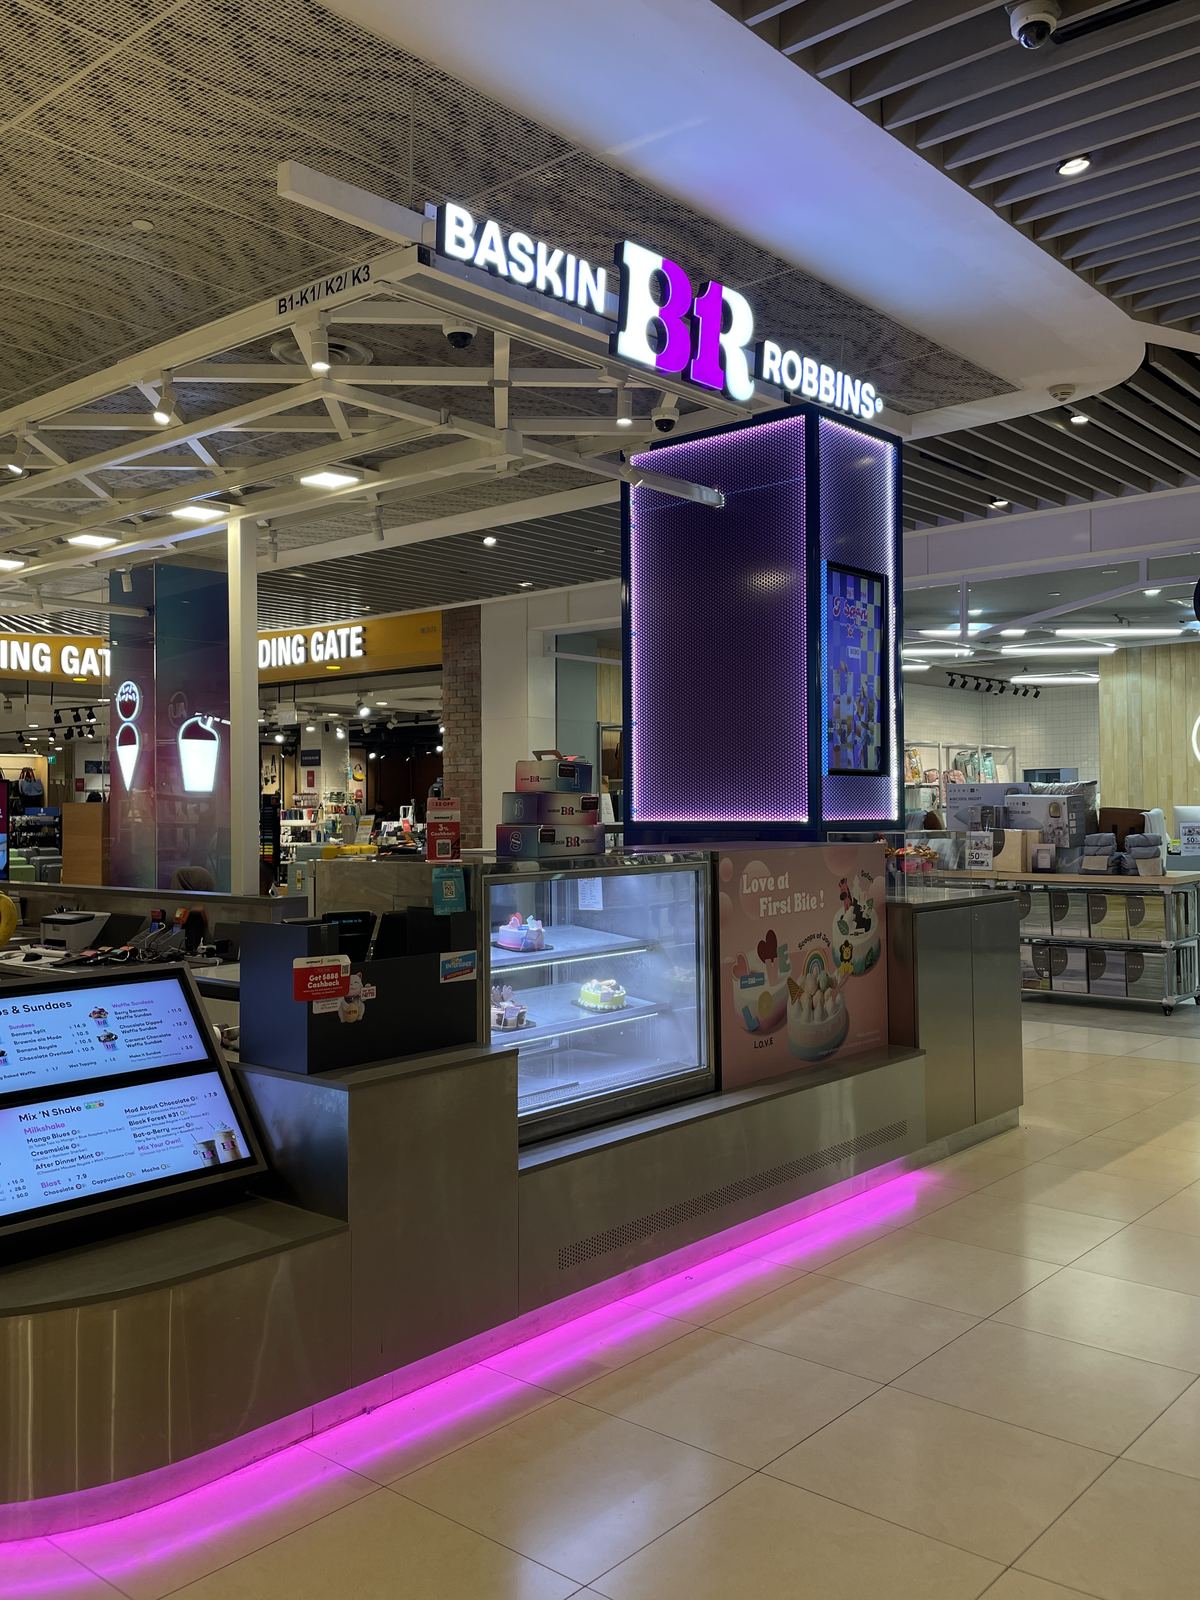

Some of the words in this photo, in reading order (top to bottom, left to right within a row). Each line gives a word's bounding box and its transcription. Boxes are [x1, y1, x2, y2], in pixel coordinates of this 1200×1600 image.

[444, 202, 606, 313] BASKIN
[278, 283, 322, 315] B1-K1/
[325, 272, 348, 296] K2/
[352, 264, 370, 286] K3
[258, 632, 305, 668] DING
[309, 625, 363, 662] GATE
[742, 873, 775, 894] Love
[777, 871, 790, 889] at
[759, 896, 791, 918] First
[793, 892, 817, 913] Bite
[307, 980, 340, 989] Cashback
[309, 974, 322, 982] Get
[11, 1005, 20, 1014] &
[22, 1001, 72, 1013] Sundaes
[19, 1054, 48, 1062] Chocolate
[159, 1097, 190, 1108] Chocolate
[18, 1112, 37, 1122] Mix
[51, 1105, 82, 1116] Shake
[147, 1114, 167, 1122] Forest
[24, 1121, 65, 1135] Milkshake
[27, 1135, 51, 1145] Mango
[51, 1132, 70, 1140] Blues
[31, 1145, 70, 1157] Creamsicle
[138, 1144, 149, 1152] Mix
[149, 1142, 163, 1150] Your
[35, 1161, 54, 1170] After
[54, 1157, 77, 1166] Dinner
[78, 1153, 94, 1161] Mint
[40, 1180, 62, 1189] Blast
[76, 1173, 87, 1181] 7.9
[43, 1185, 75, 1197] Chocolate
